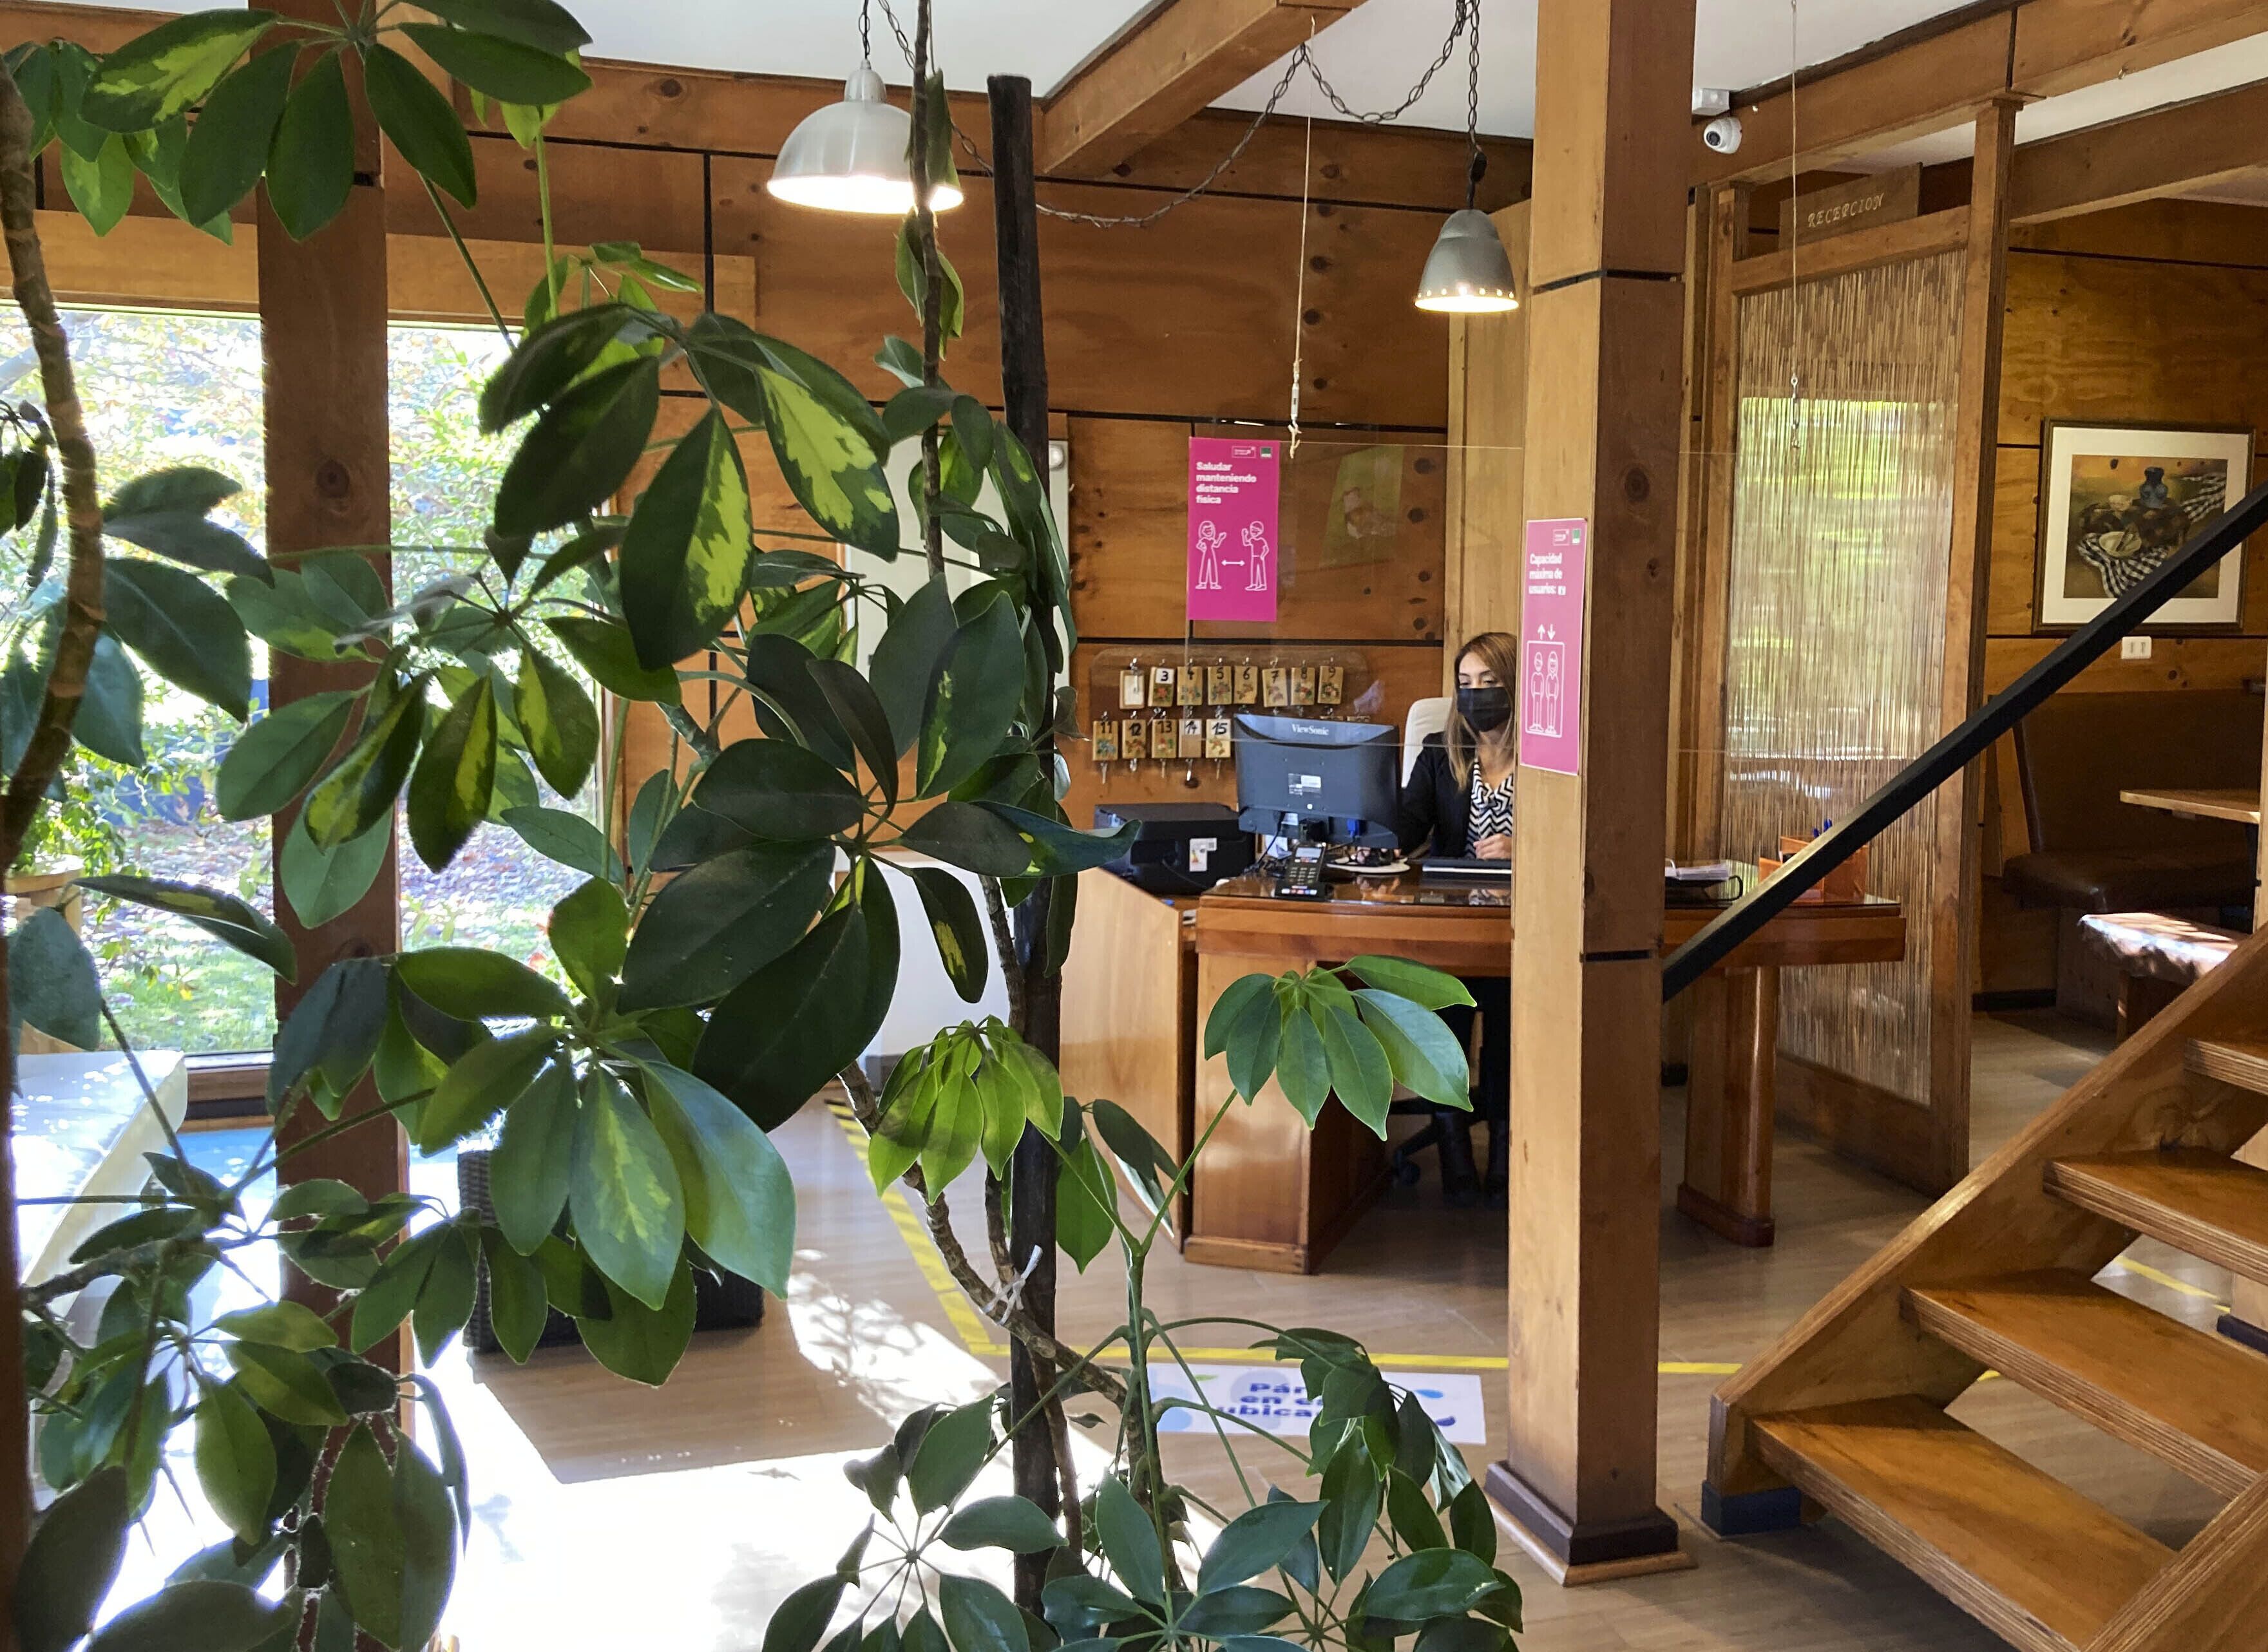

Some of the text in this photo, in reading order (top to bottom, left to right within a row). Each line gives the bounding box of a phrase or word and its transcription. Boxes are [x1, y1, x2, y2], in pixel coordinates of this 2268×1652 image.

[1807, 193, 1885, 227] RECEPCION
[1196, 462, 1232, 471] Saludar
[1196, 473, 1257, 482] manteniendo
[1196, 484, 1239, 493] distancia
[1530, 553, 1562, 567] Capacidad
[1554, 568, 1563, 580] de
[1160, 670, 1169, 681] 3
[1187, 669, 1195, 680] 4
[1216, 667, 1224, 679] 5
[1243, 667, 1251, 679] 6
[1270, 670, 1279, 683] 7
[1329, 667, 1336, 678] 9
[1100, 721, 1112, 734] 11
[1129, 723, 1141, 736] 12
[1157, 721, 1172, 734] 13
[1212, 723, 1228, 735] 15
[1292, 724, 1329, 736] ViewSonic
[1250, 1383, 1307, 1393] Pár
[1240, 1396, 1282, 1404] en
[1217, 1405, 1318, 1417] ubica
